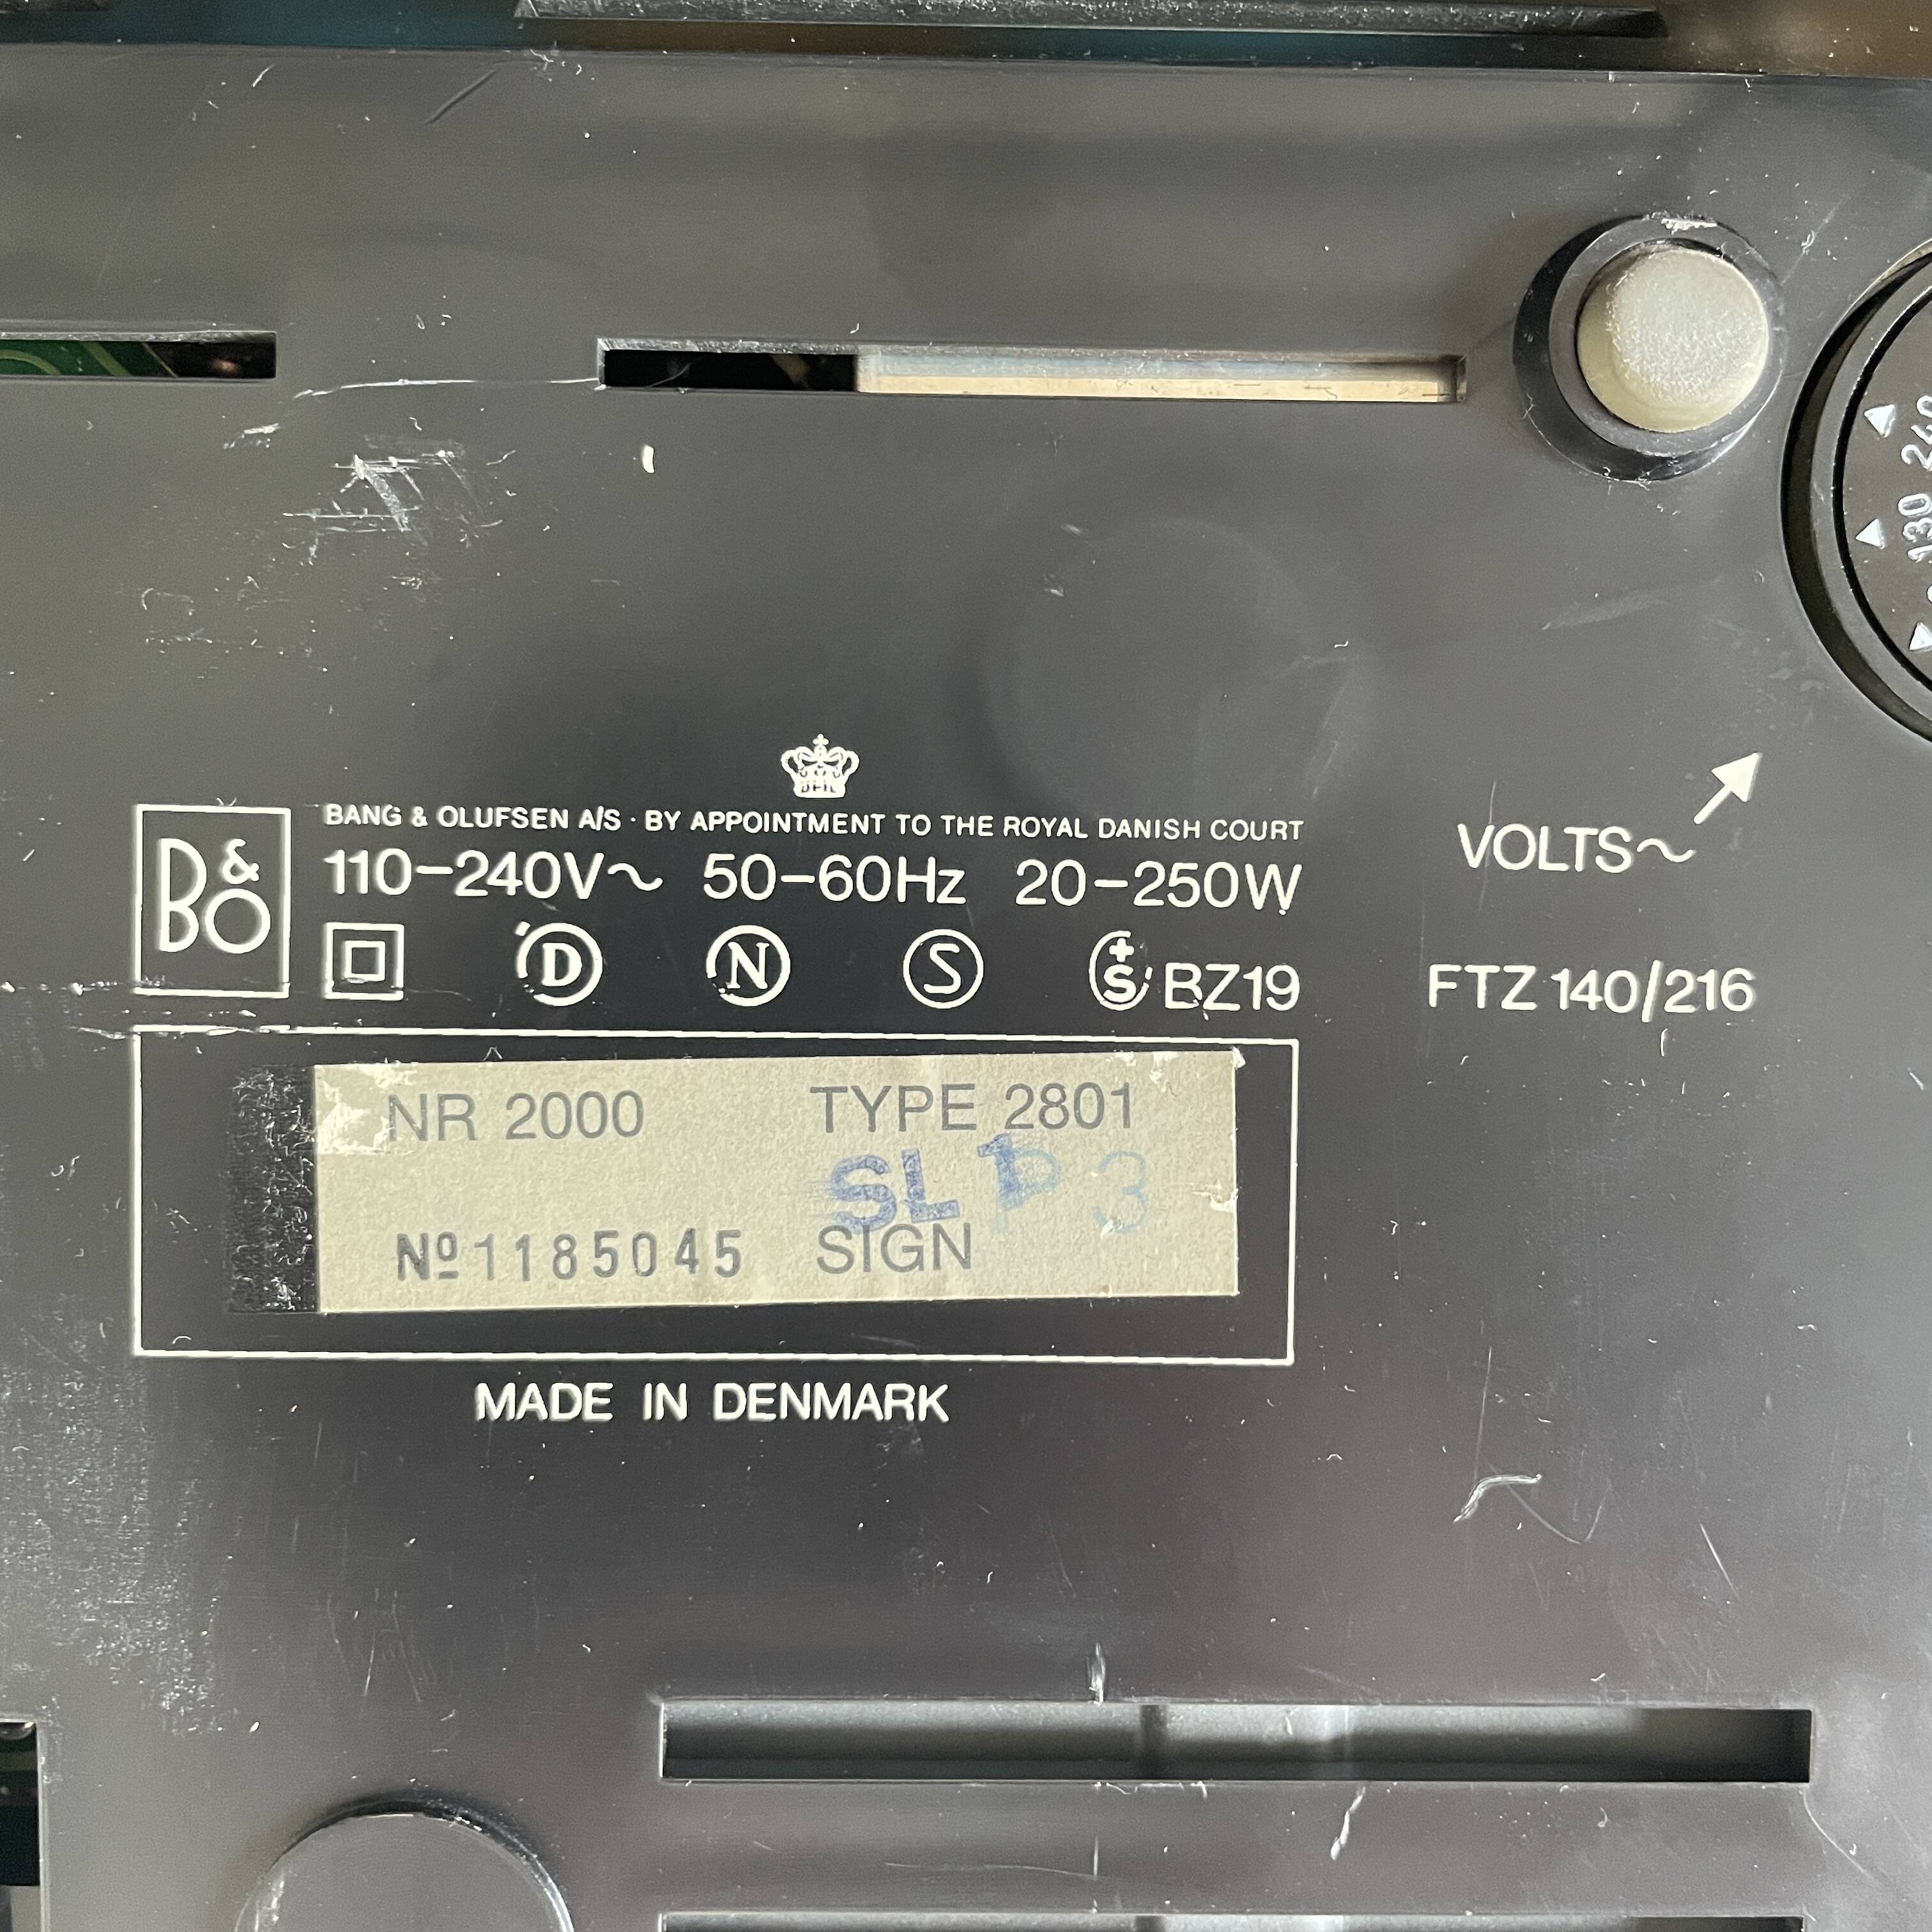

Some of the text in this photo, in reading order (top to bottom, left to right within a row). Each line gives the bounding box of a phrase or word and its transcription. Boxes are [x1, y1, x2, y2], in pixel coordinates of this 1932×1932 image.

[323, 802, 1305, 842] BANG & OLUFSEN A/S BY APPOINTMENT TO THE ROYAL DANISH COURT
[703, 852, 967, 905] 50-60Hz
[1015, 858, 1303, 907] 20-250W
[1164, 962, 1301, 1012] BZ19
[1428, 959, 1757, 1023] FTZ 140/216
[388, 1090, 644, 1142] NR 2000
[809, 1081, 1131, 1134] TYPE 2801
[828, 1147, 960, 1233] SL
[816, 1222, 972, 1274] SIGN
[475, 1381, 950, 1423] MADE IN DENMARK
